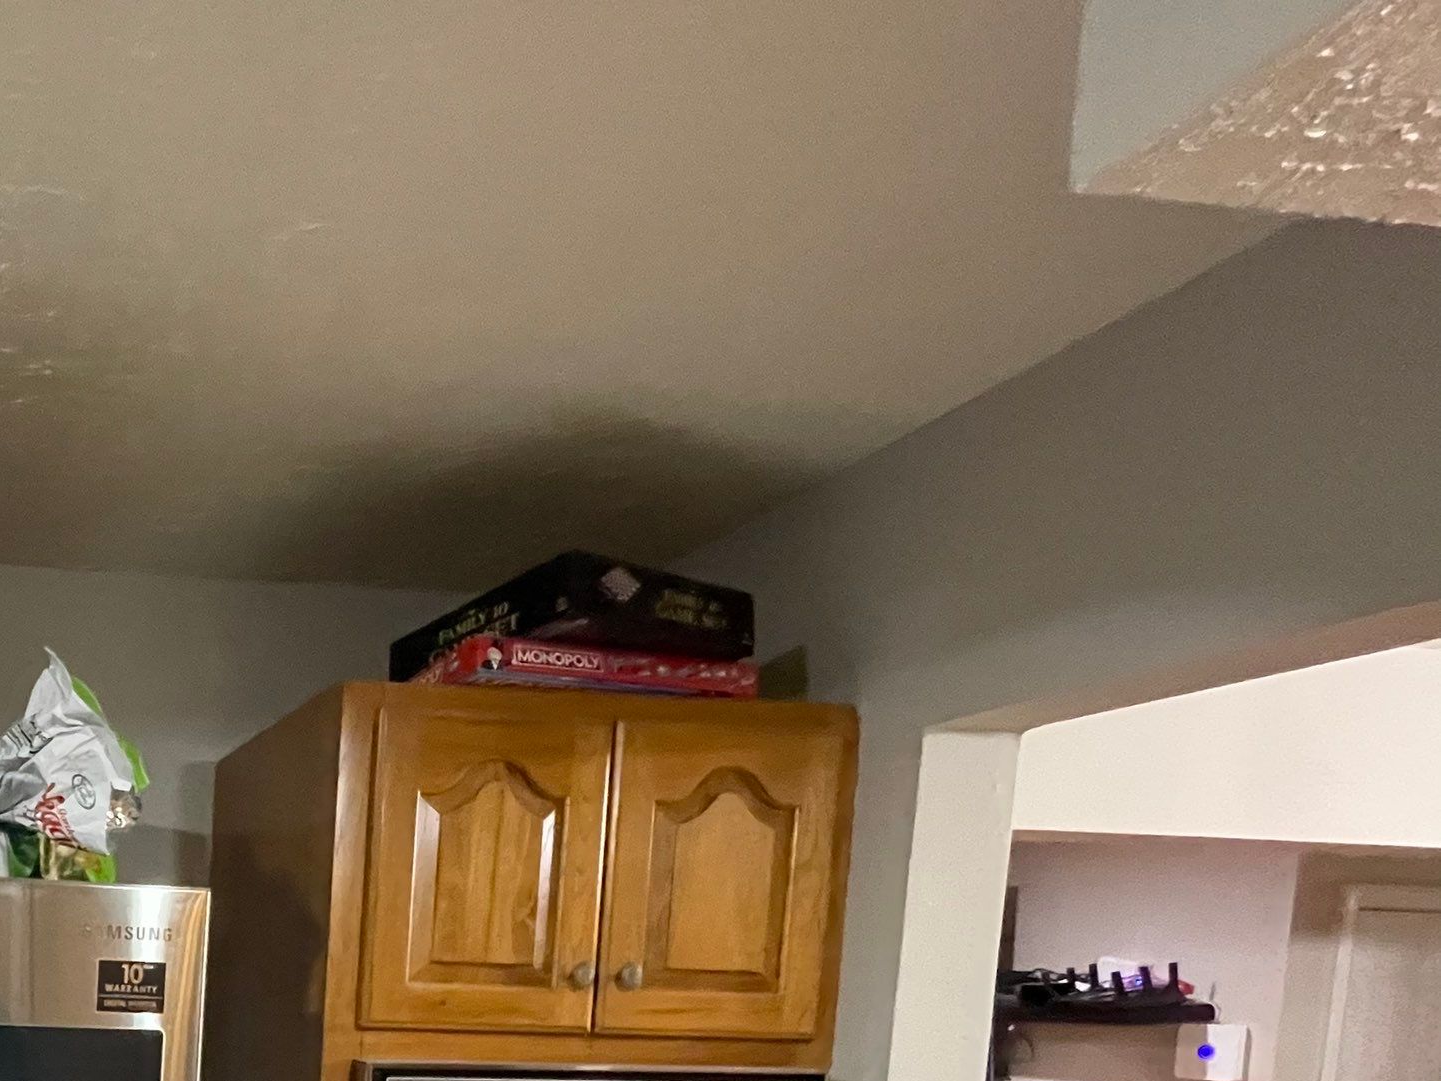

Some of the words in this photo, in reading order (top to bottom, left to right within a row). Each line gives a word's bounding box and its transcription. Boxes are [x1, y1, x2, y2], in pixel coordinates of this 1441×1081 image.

[516, 650, 600, 669] MONOPOLY
[82, 924, 173, 942] MSUNG
[121, 963, 144, 984] 10
[104, 984, 159, 994] WARRANTY
